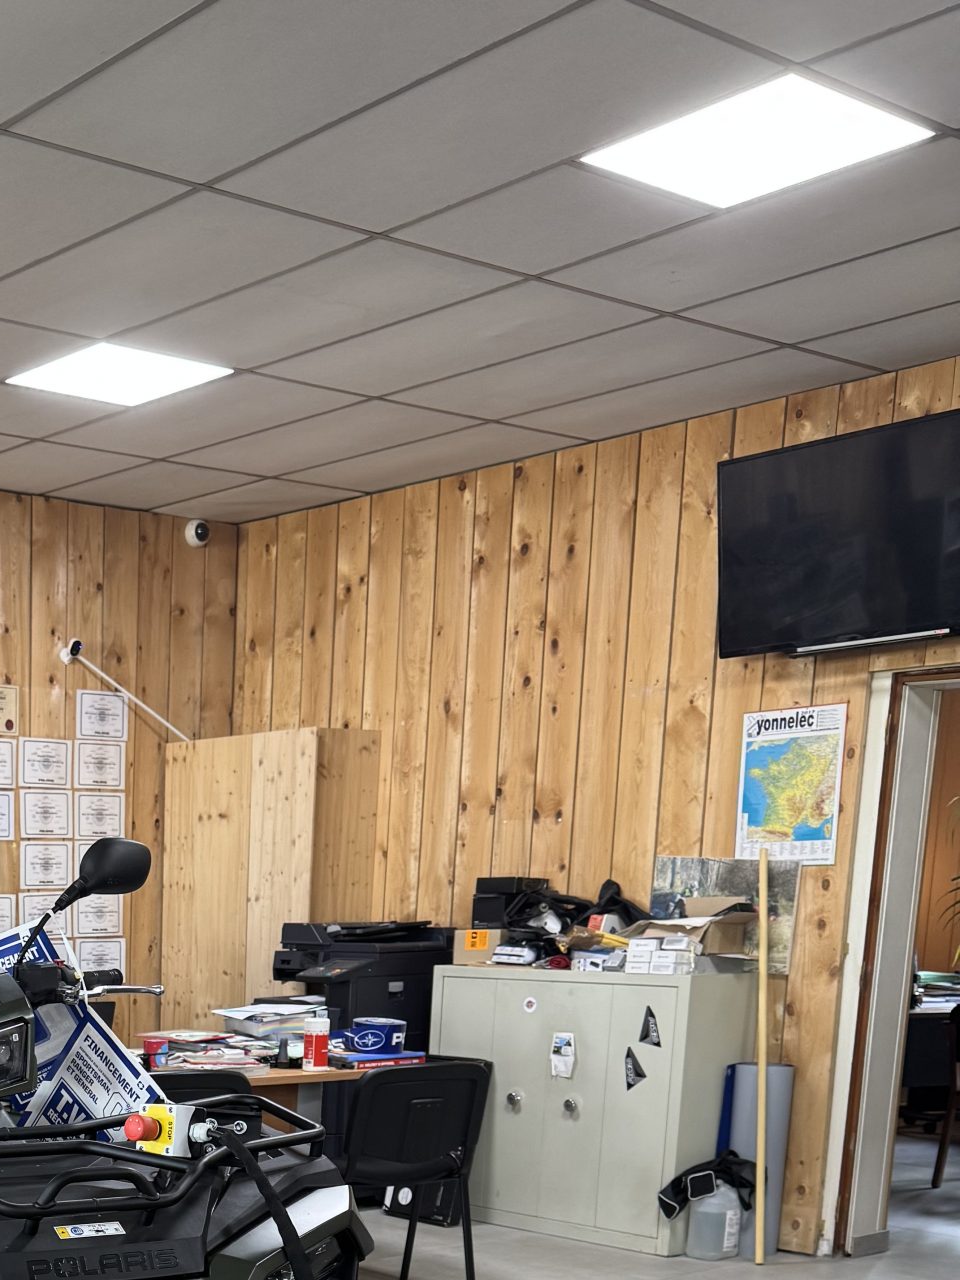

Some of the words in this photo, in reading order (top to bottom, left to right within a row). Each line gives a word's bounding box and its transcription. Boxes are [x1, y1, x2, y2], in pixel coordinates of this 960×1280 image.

[756, 711, 815, 736] yonnelec
[391, 1032, 406, 1046] P
[70, 1058, 95, 1087] RANGER
[74, 1051, 110, 1096] SPORTSMAN,
[83, 1034, 141, 1103] FINANCEMENT
[66, 1065, 76, 1076] ET
[73, 1073, 98, 1105] GENERAL
[26, 1249, 180, 1280] POLARIS
